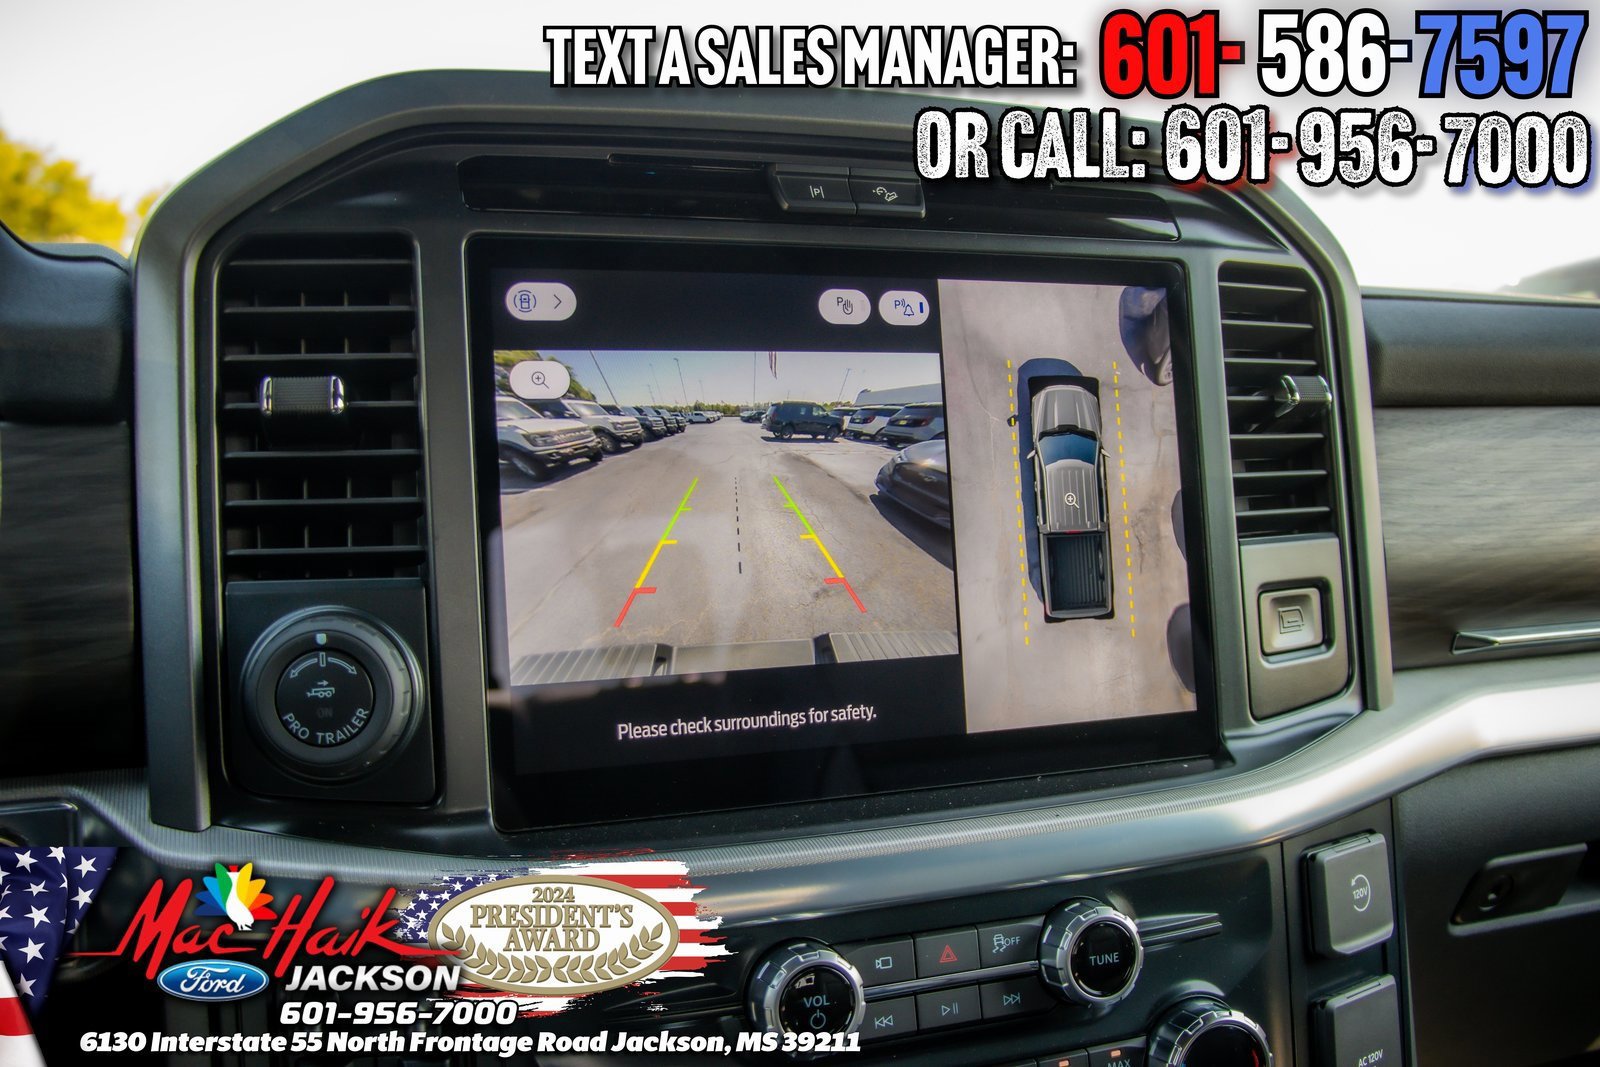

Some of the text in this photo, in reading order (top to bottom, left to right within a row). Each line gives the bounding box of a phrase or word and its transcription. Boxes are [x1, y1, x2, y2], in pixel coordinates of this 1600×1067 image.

[282, 708, 369, 744] PRO TRAILER
[618, 704, 877, 740] Please check surroundings for safety.
[1004, 936, 1021, 946] OFF
[1089, 952, 1120, 967] TUNE
[803, 995, 830, 1008] VOL
[1359, 1049, 1383, 1067] AC 120V
